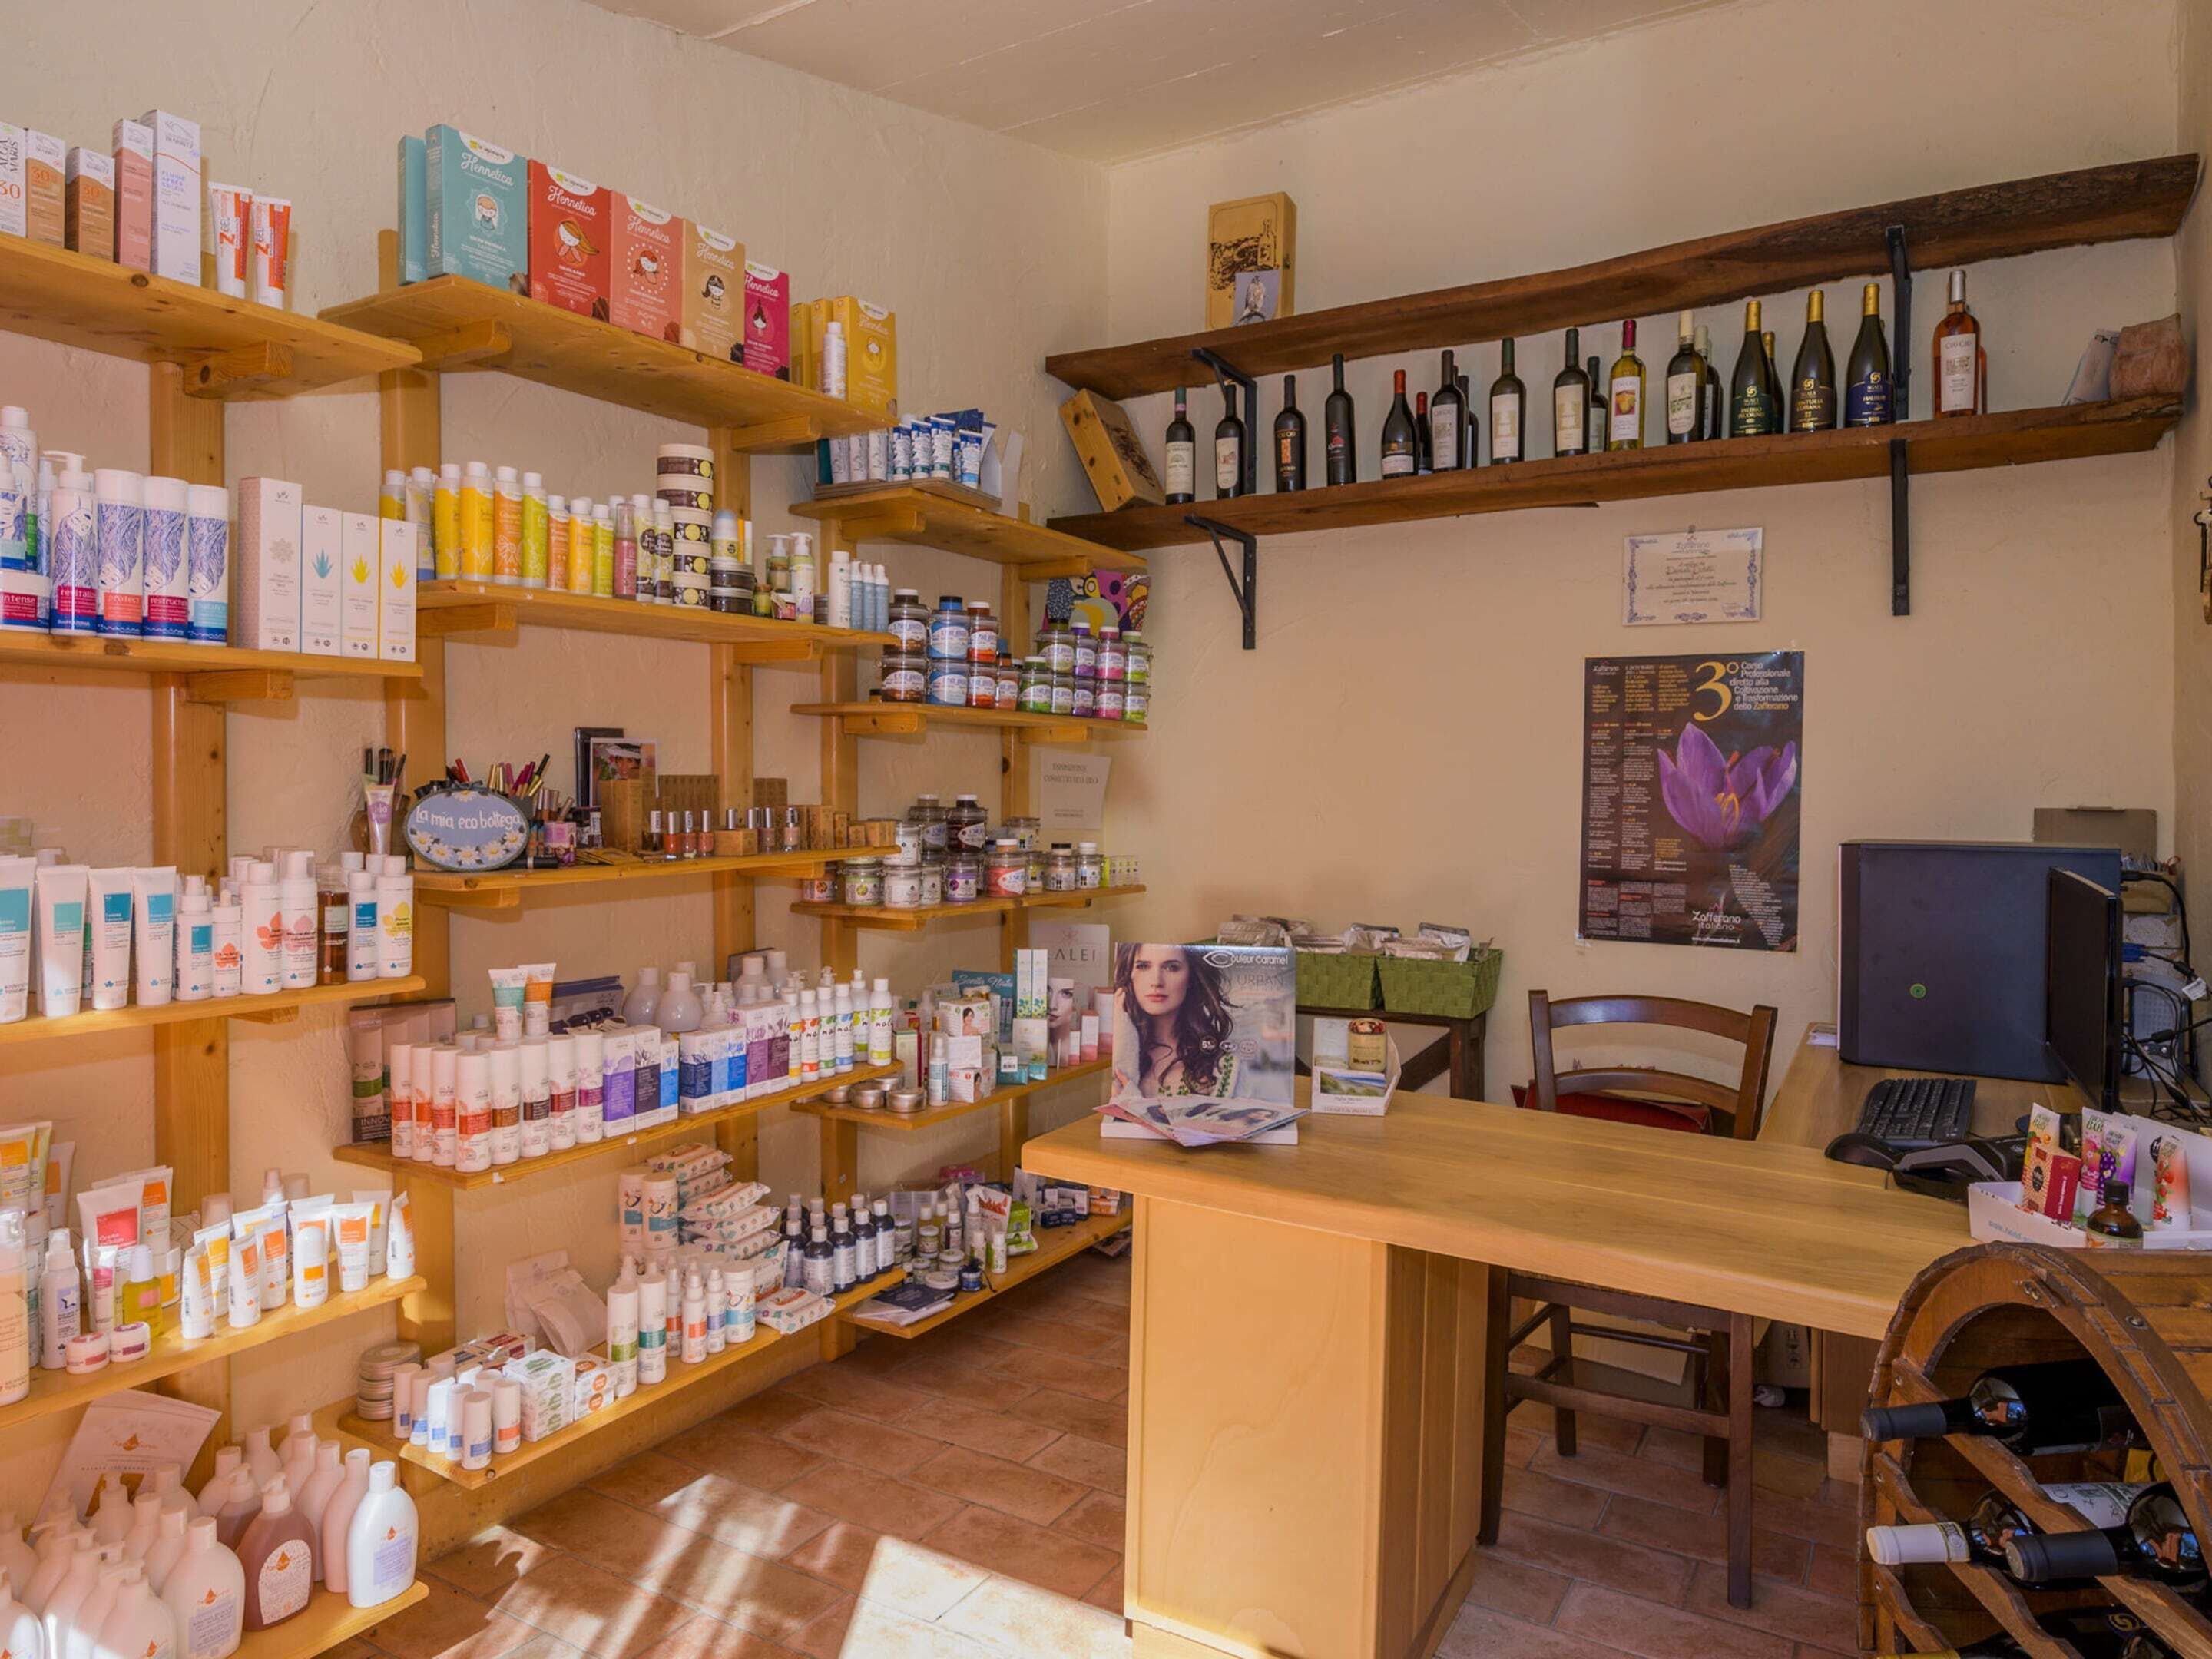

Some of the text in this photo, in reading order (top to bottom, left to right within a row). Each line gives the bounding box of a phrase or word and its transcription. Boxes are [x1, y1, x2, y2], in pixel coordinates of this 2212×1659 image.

[461, 152, 515, 187] Hennetica
[548, 185, 597, 217] Hennetica
[627, 216, 671, 244] Hennetica
[1741, 668, 1791, 678] Professionale
[1755, 677, 1770, 686] alla
[1734, 686, 1779, 694] Coltivazione
[1743, 694, 1798, 702] Trasformazione
[1753, 702, 1790, 710] Zafferano
[416, 806, 522, 831] La mia eco bottega
[1692, 910, 1741, 924] Zafferano
[1699, 922, 1734, 931] italiano
[1048, 948, 1096, 962] ALEI
